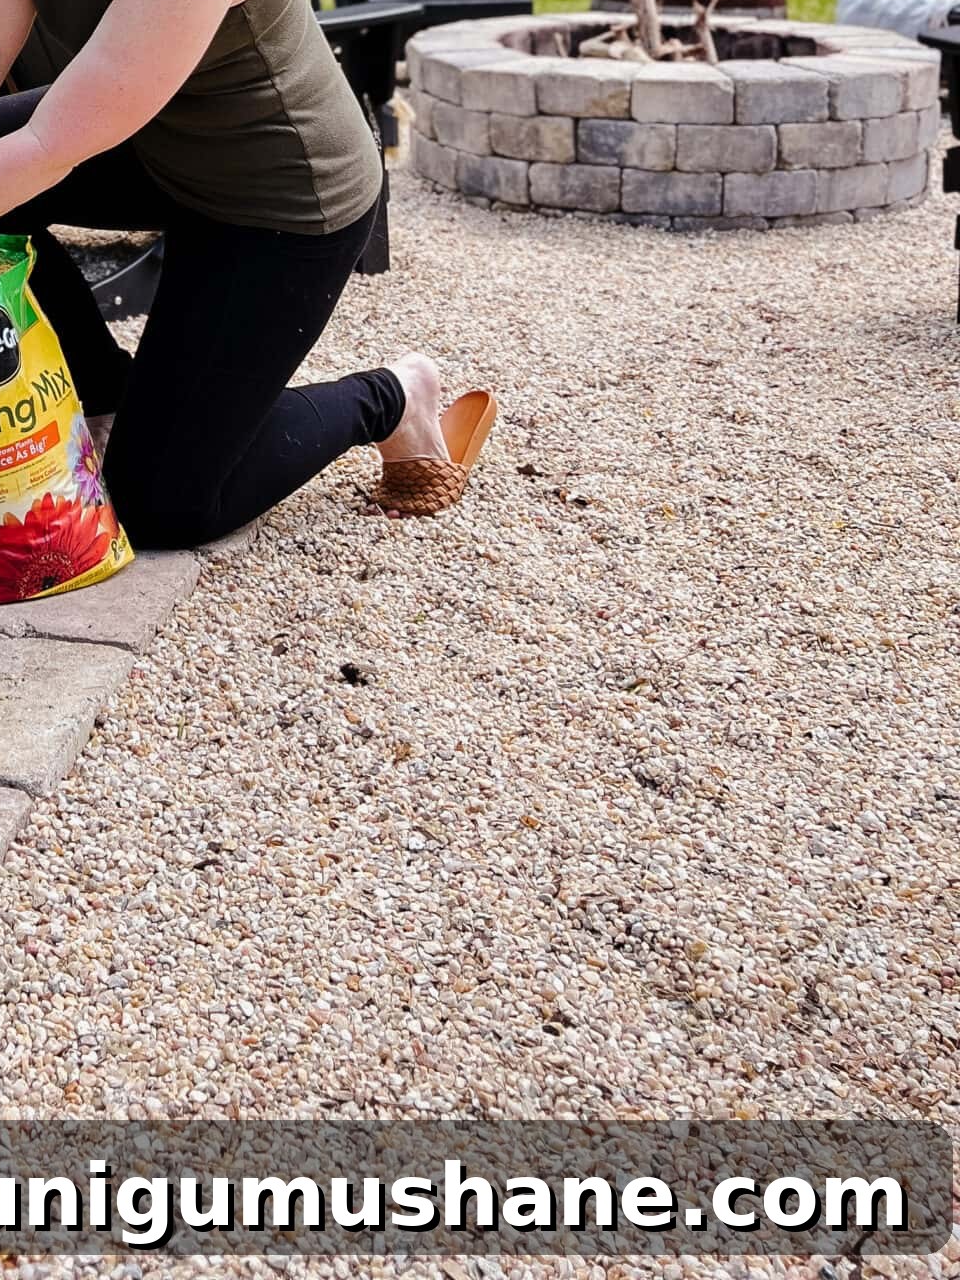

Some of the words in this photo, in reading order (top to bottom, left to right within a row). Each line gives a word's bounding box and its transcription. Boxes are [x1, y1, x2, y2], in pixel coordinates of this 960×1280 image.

[31, 365, 72, 412] Mix
[16, 450, 28, 461] As
[29, 437, 47, 454] Big!
